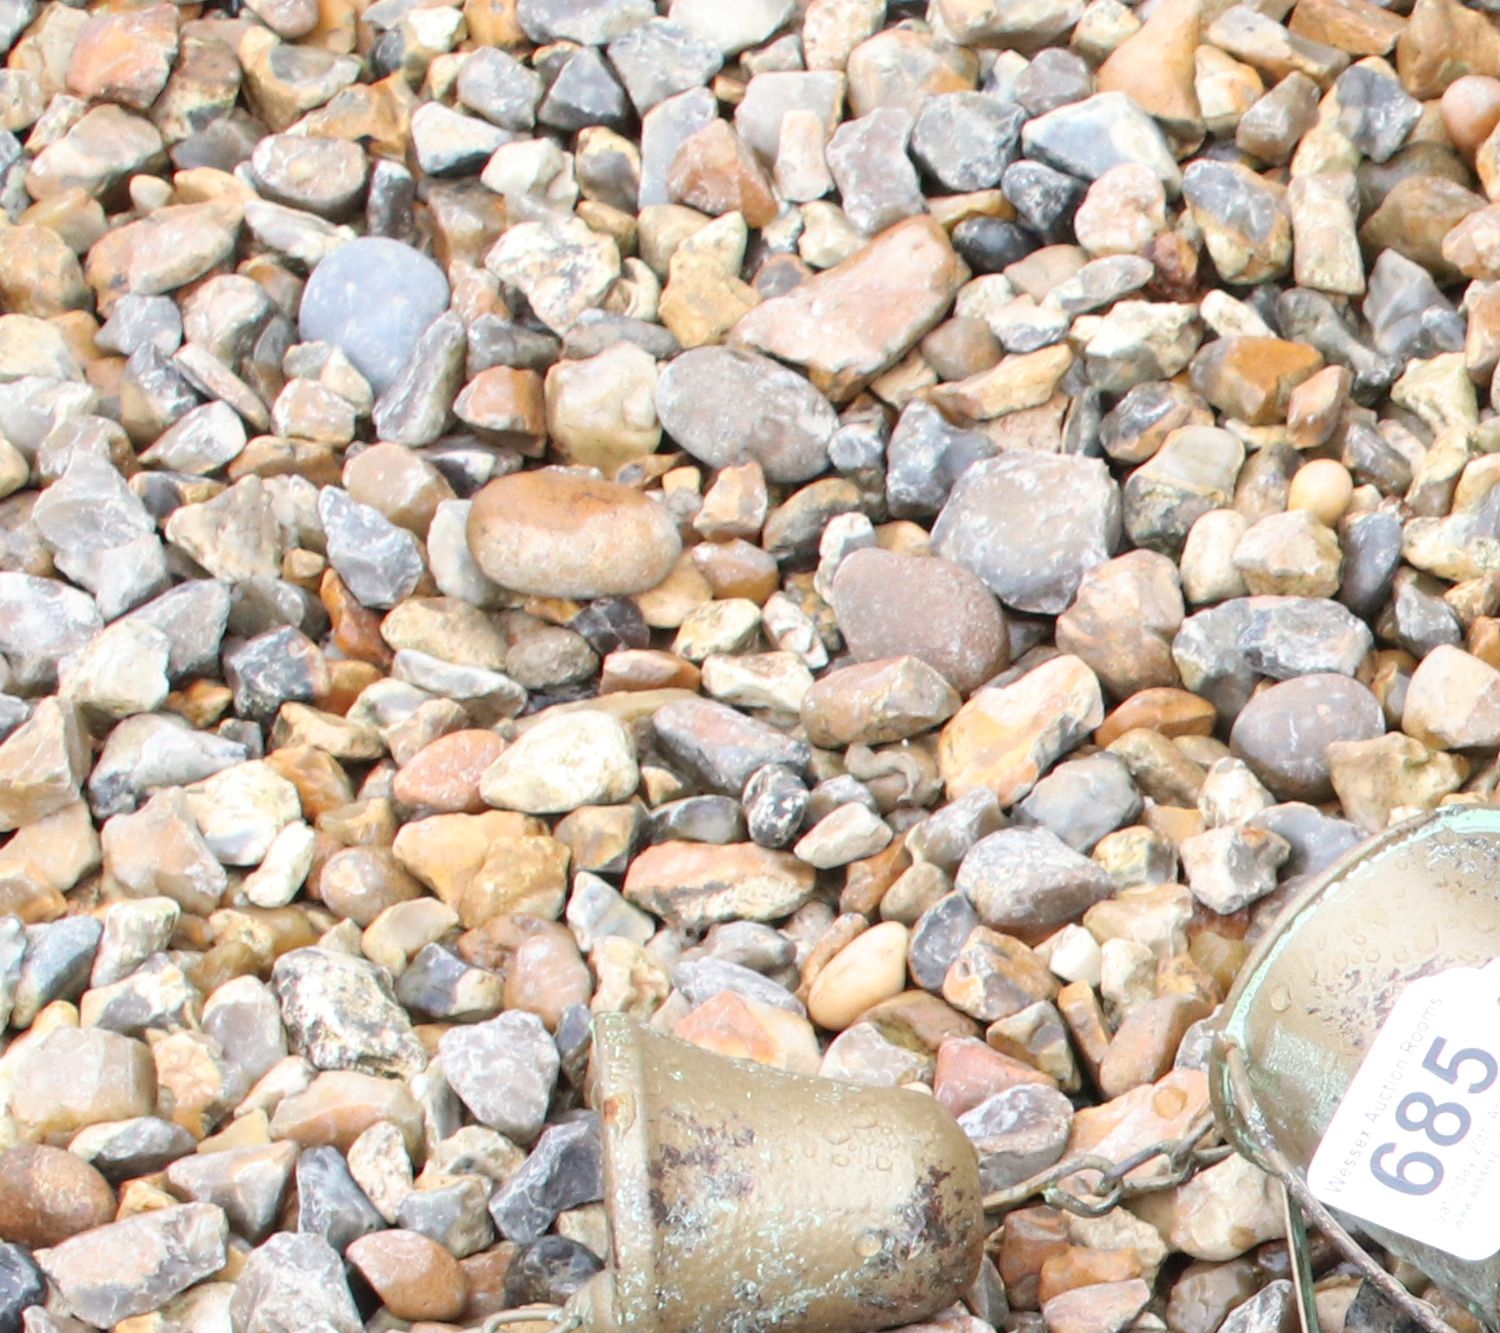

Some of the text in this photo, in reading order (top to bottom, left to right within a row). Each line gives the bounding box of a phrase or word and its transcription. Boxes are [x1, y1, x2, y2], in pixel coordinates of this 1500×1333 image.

[1325, 996, 1443, 1194] Wessex Auction Rooms
[1369, 1035, 1499, 1197] 685
